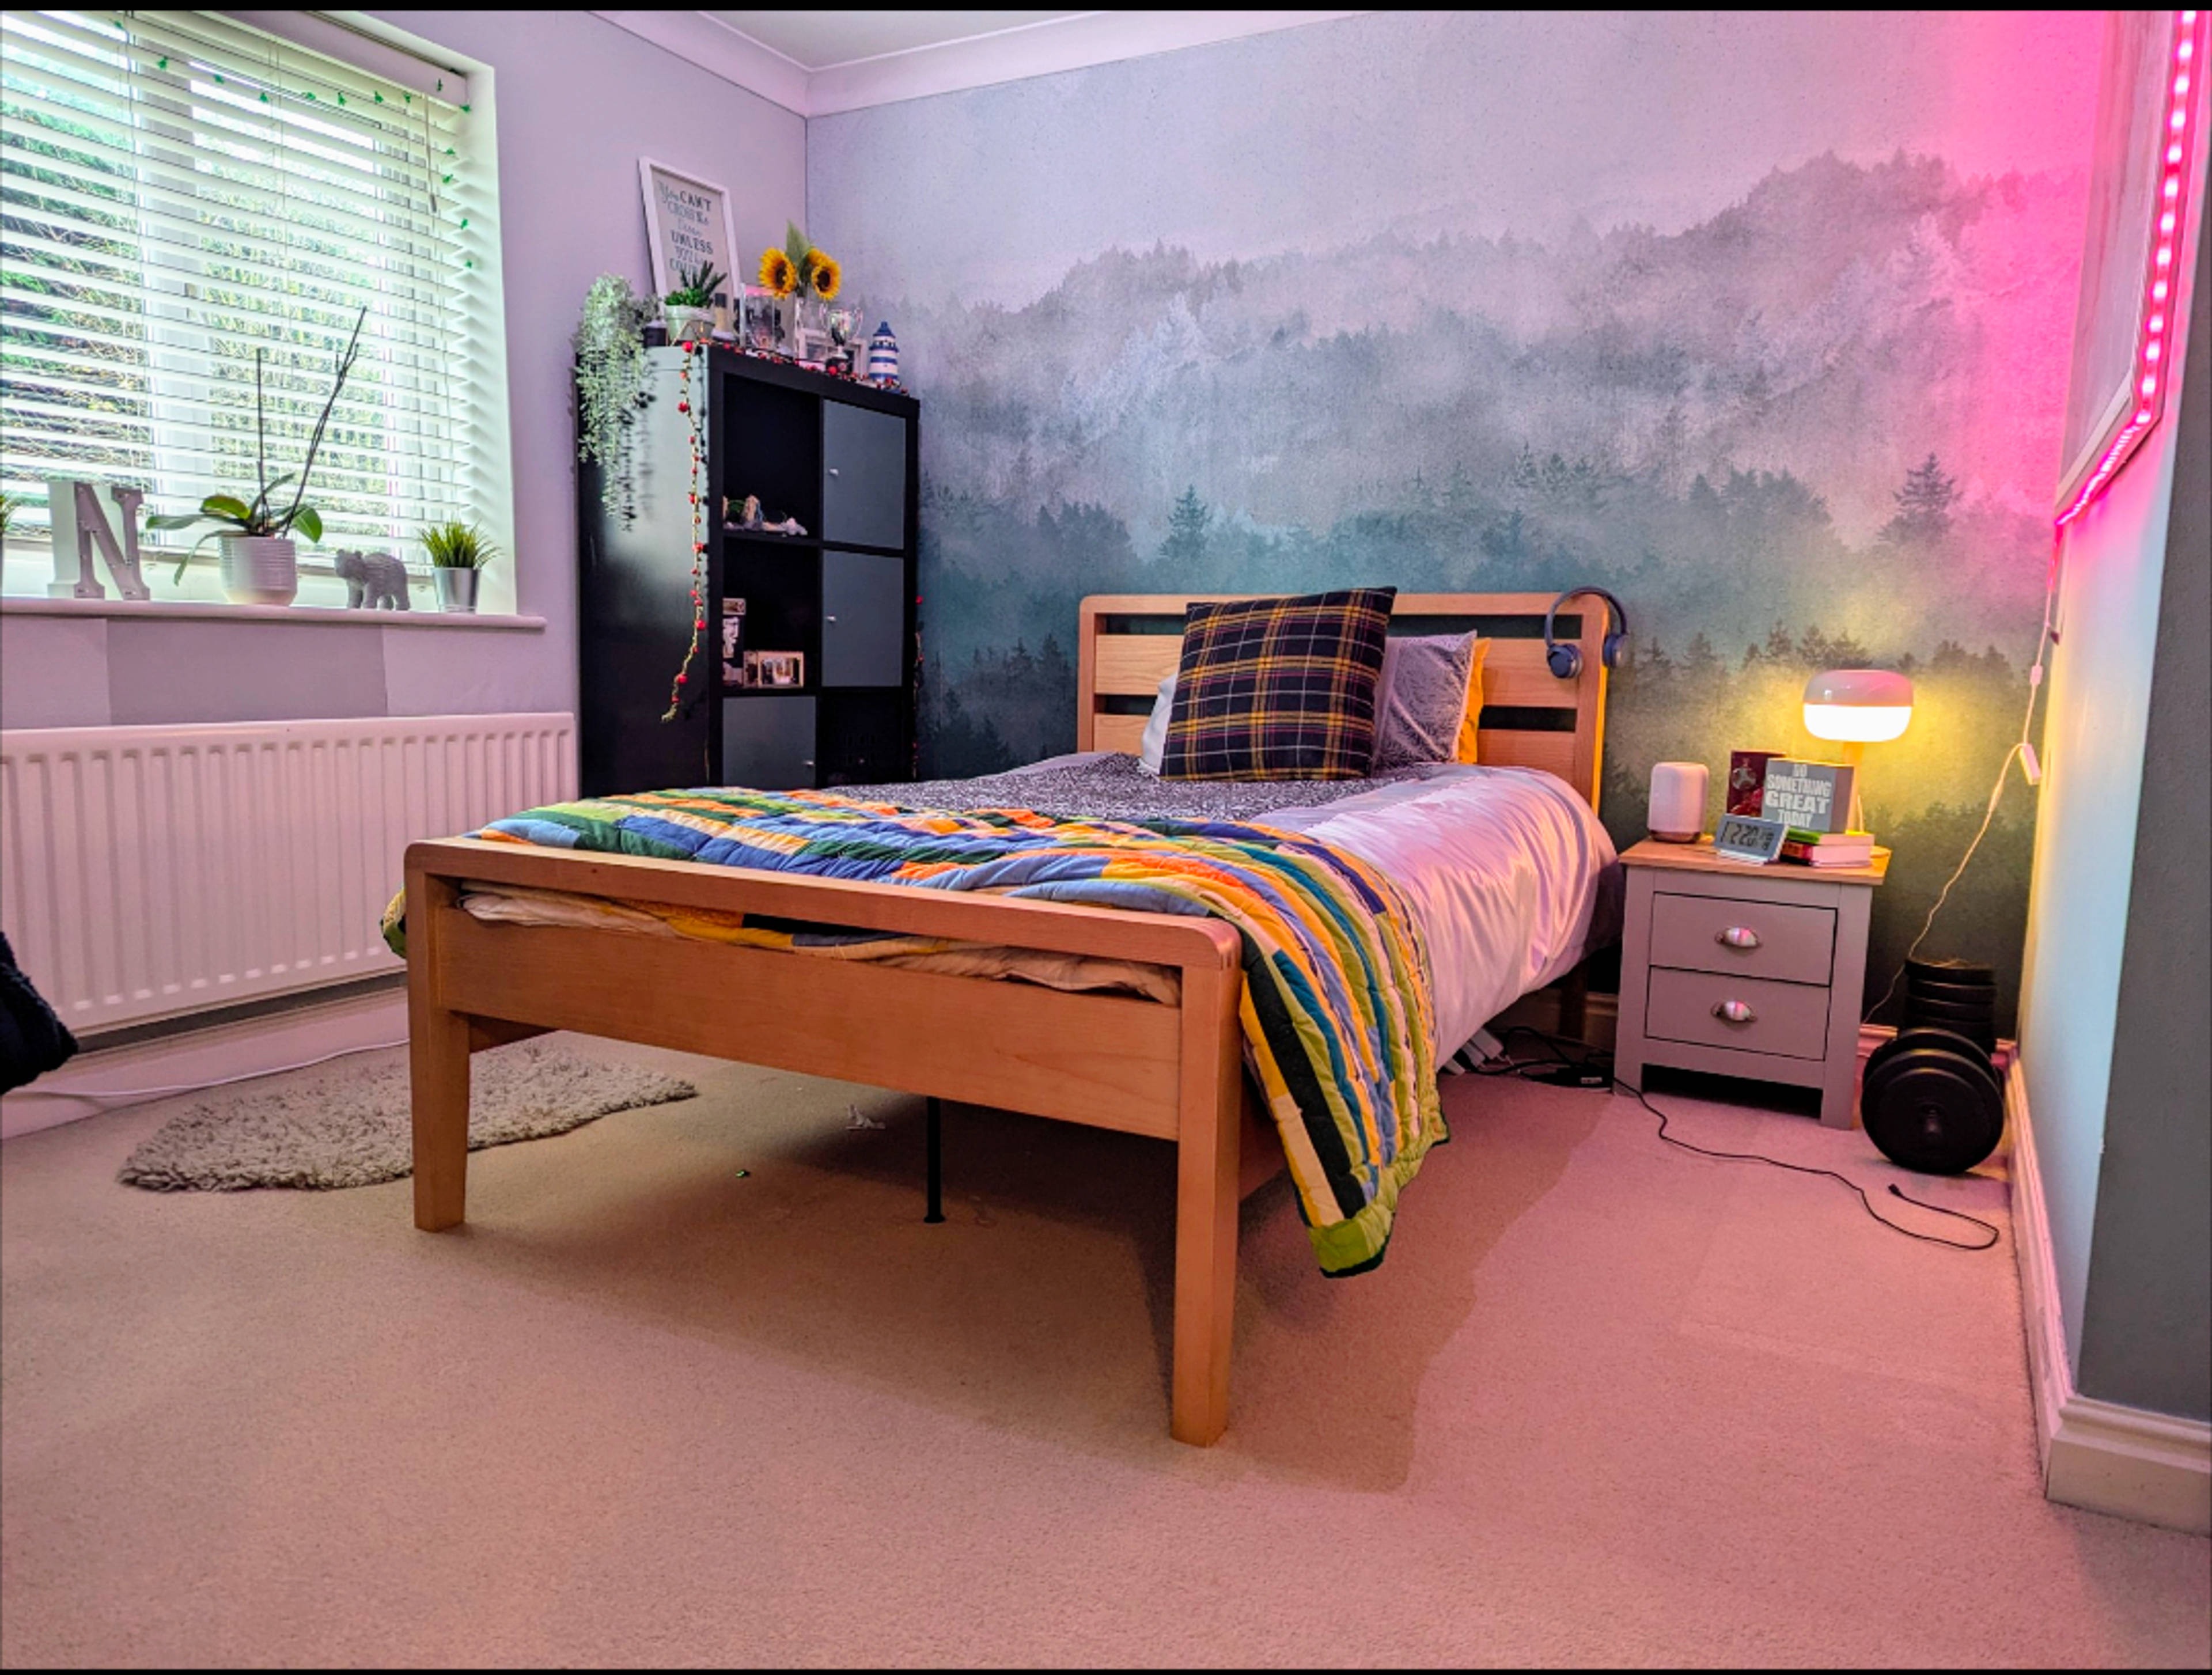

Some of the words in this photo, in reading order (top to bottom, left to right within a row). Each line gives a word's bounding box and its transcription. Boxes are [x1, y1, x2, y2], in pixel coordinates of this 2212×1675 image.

[670, 229, 713, 254] UNLESS
[74, 482, 150, 600] N
[1793, 764, 1808, 779] DO
[1767, 774, 1832, 798] SOMETHING
[1765, 790, 1830, 814] GREAT
[1777, 809, 1813, 828] TODAY
